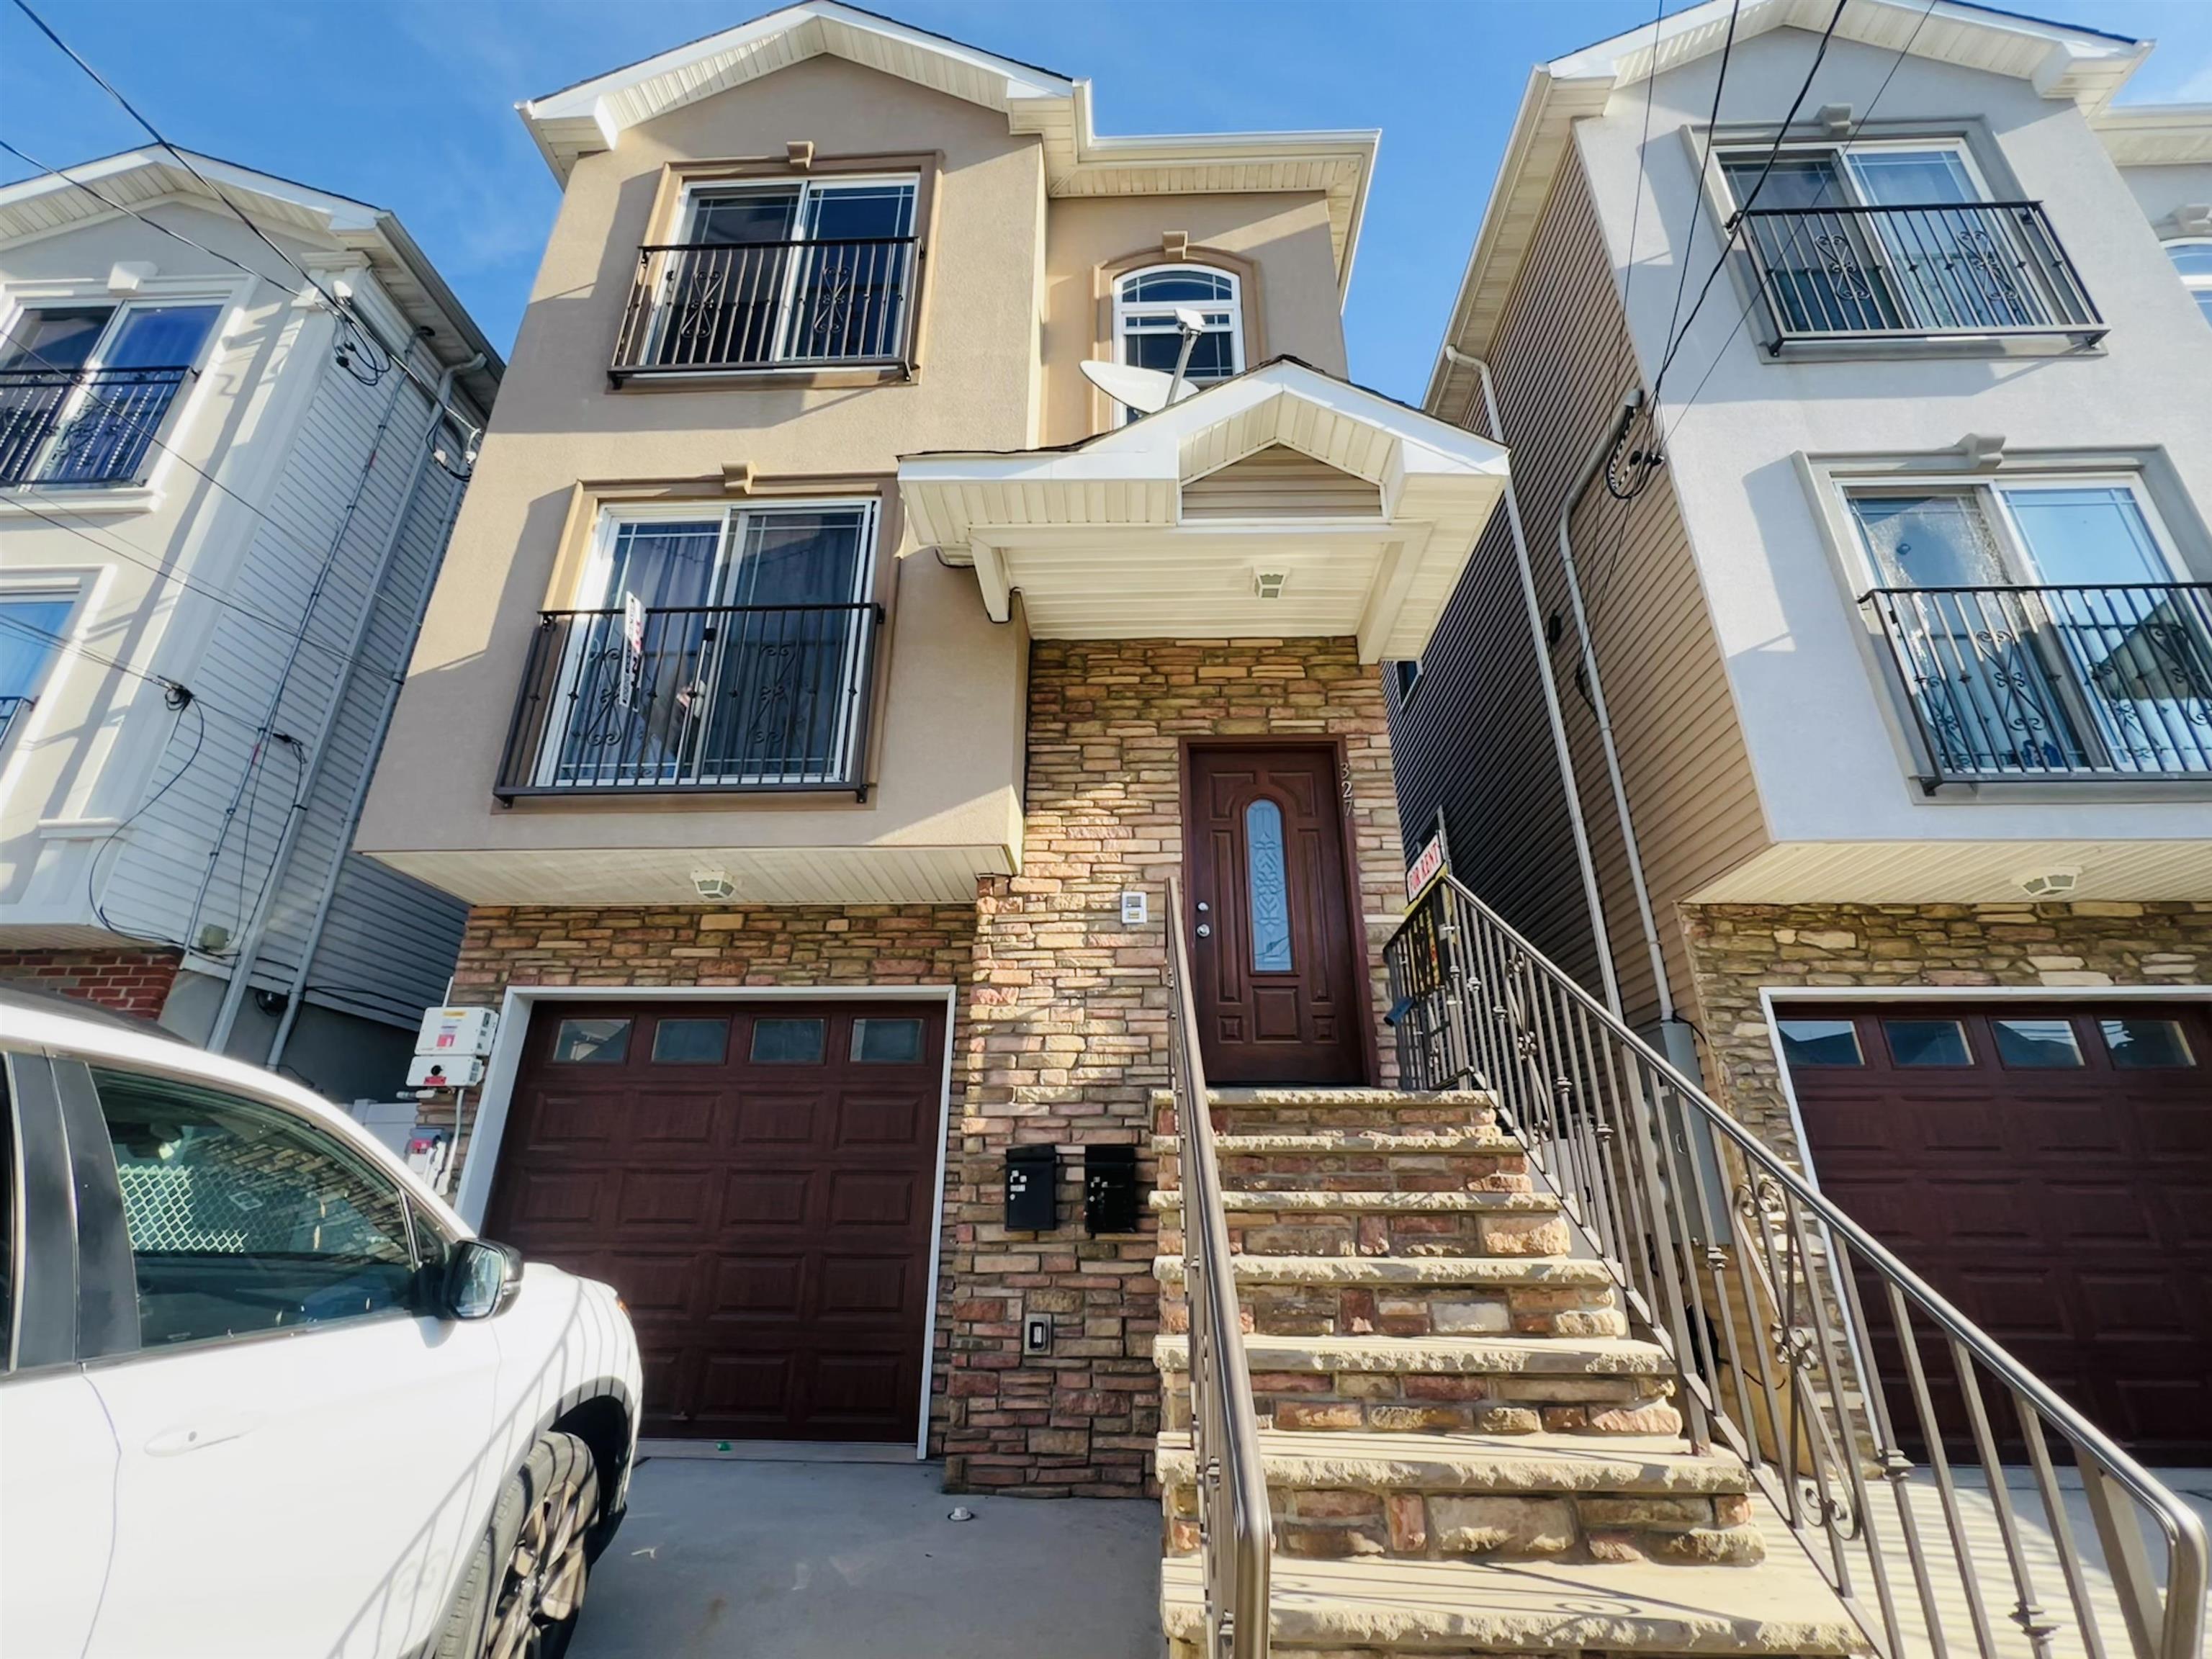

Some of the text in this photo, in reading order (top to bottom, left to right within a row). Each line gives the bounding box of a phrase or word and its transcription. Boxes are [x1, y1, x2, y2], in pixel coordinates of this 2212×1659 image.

[1339, 762, 1353, 817] 327
[1410, 841, 1440, 894] FOR RENT
